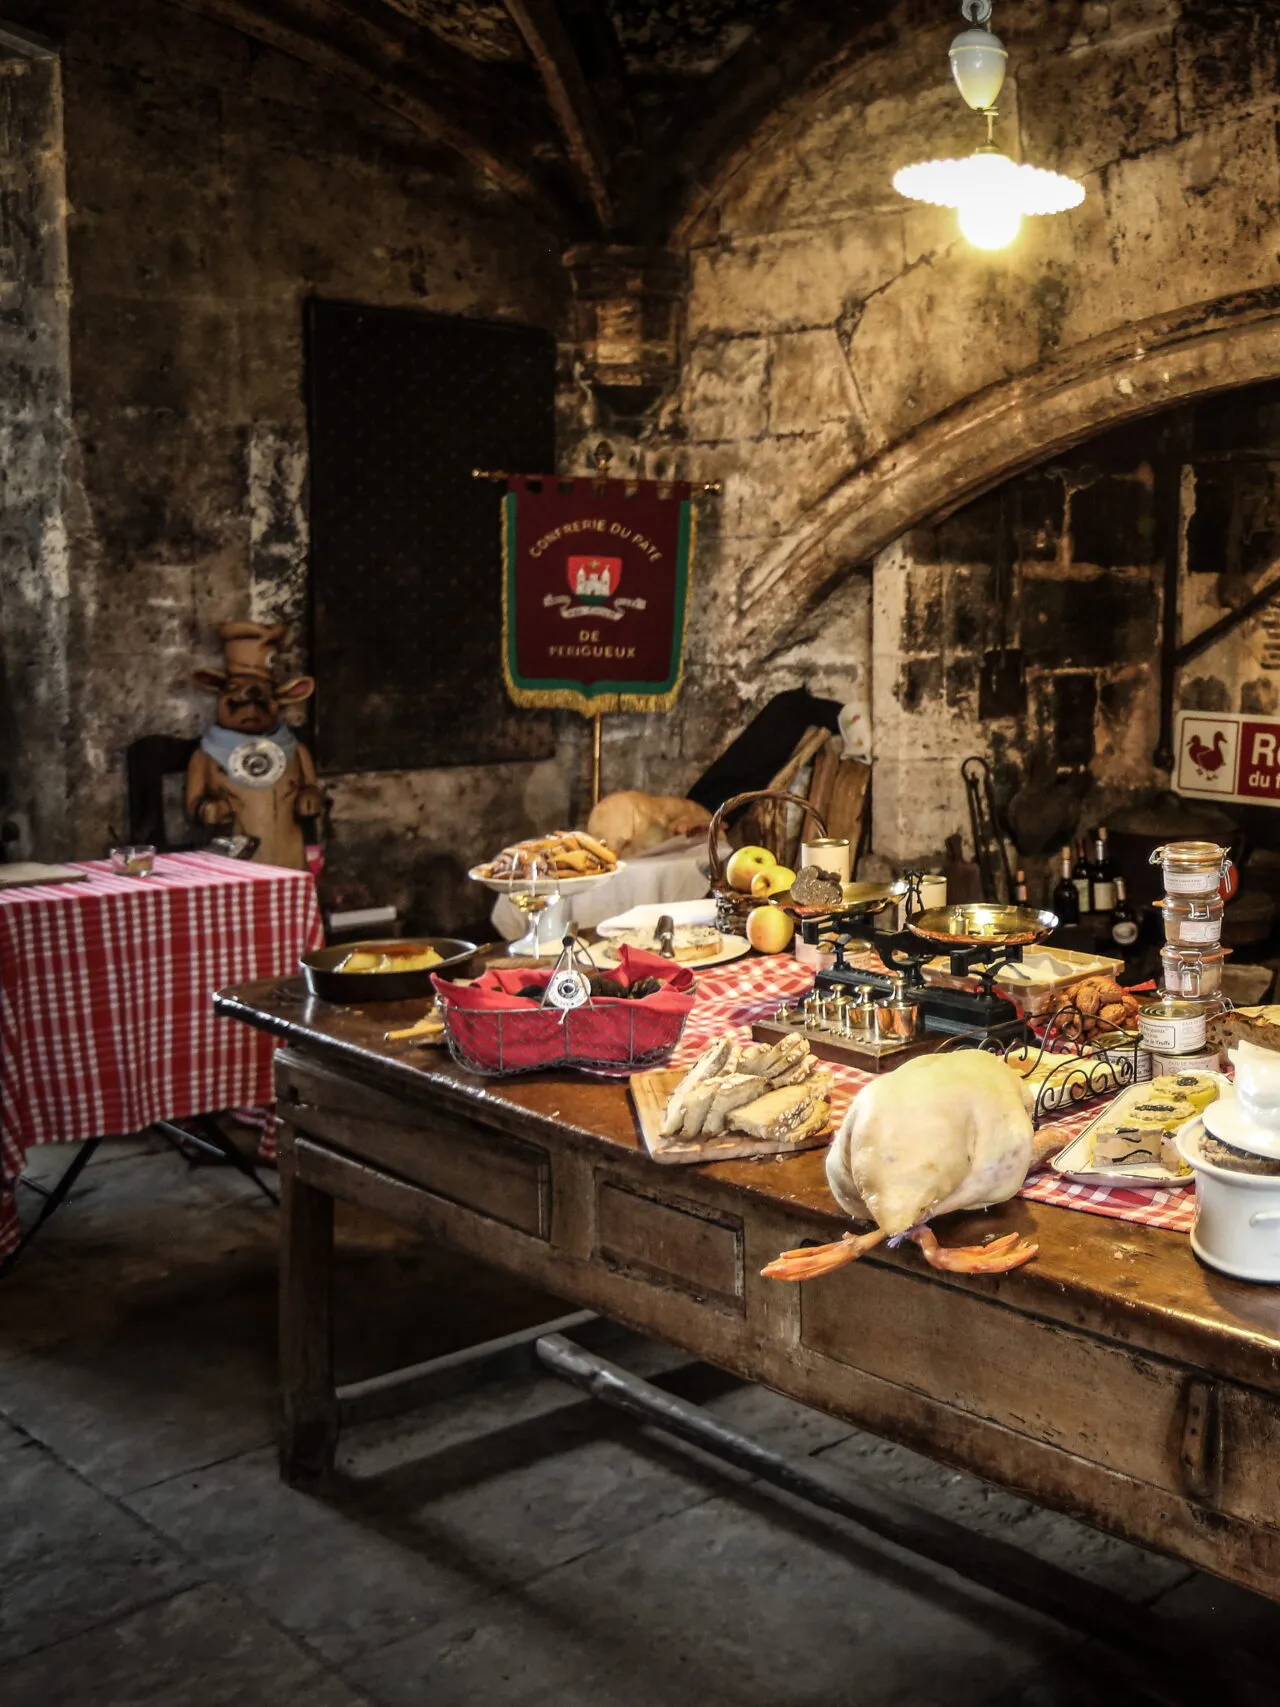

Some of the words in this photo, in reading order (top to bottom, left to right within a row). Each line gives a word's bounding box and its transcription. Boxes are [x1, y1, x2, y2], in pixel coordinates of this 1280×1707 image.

[609, 522, 632, 539] DU
[579, 630, 600, 643] DE
[1248, 771, 1271, 788] du
